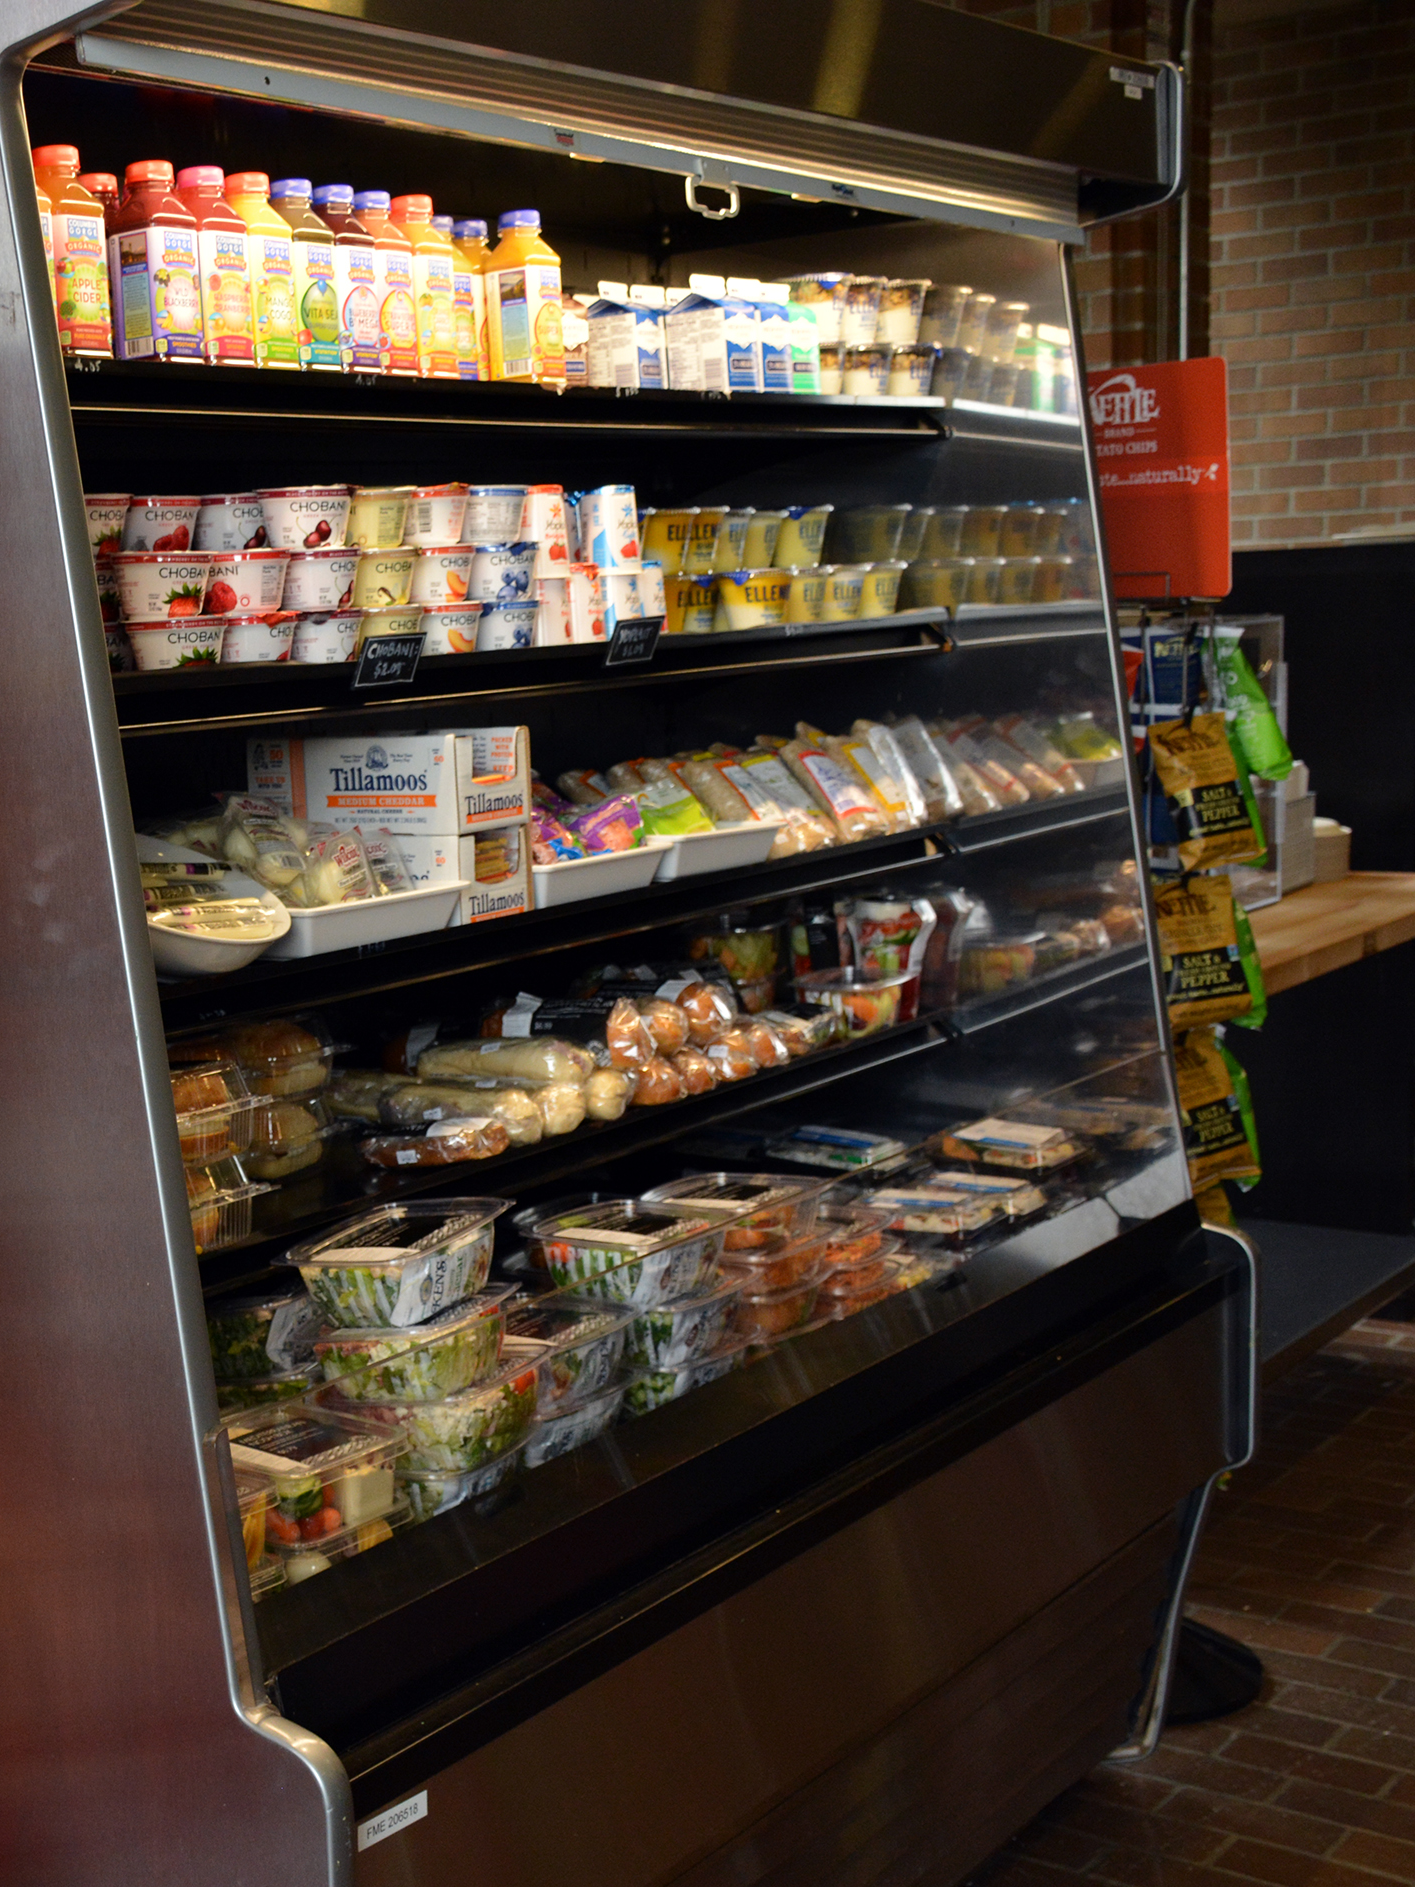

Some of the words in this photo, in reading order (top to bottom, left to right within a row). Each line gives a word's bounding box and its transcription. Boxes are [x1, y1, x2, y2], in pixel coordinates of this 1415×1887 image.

[66, 240, 102, 255] ORGANIC
[72, 277, 101, 291] APPLE
[73, 290, 102, 304] CIDER
[1104, 427, 1135, 438] BRAND
[1125, 440, 1158, 455] CHIPS
[330, 767, 427, 793] Tillamoos
[338, 796, 377, 806] MEDIUM
[378, 795, 426, 806] CHEDDAR
[1201, 788, 1226, 802] SALT
[465, 791, 523, 815] Tillamoos
[1202, 805, 1240, 822] PEPPER
[469, 891, 525, 916] Tillamoos
[1182, 954, 1212, 969] SALT
[1181, 971, 1230, 988] PEPPER
[366, 1819, 386, 1840] FME
[388, 1802, 419, 1828] 206518
